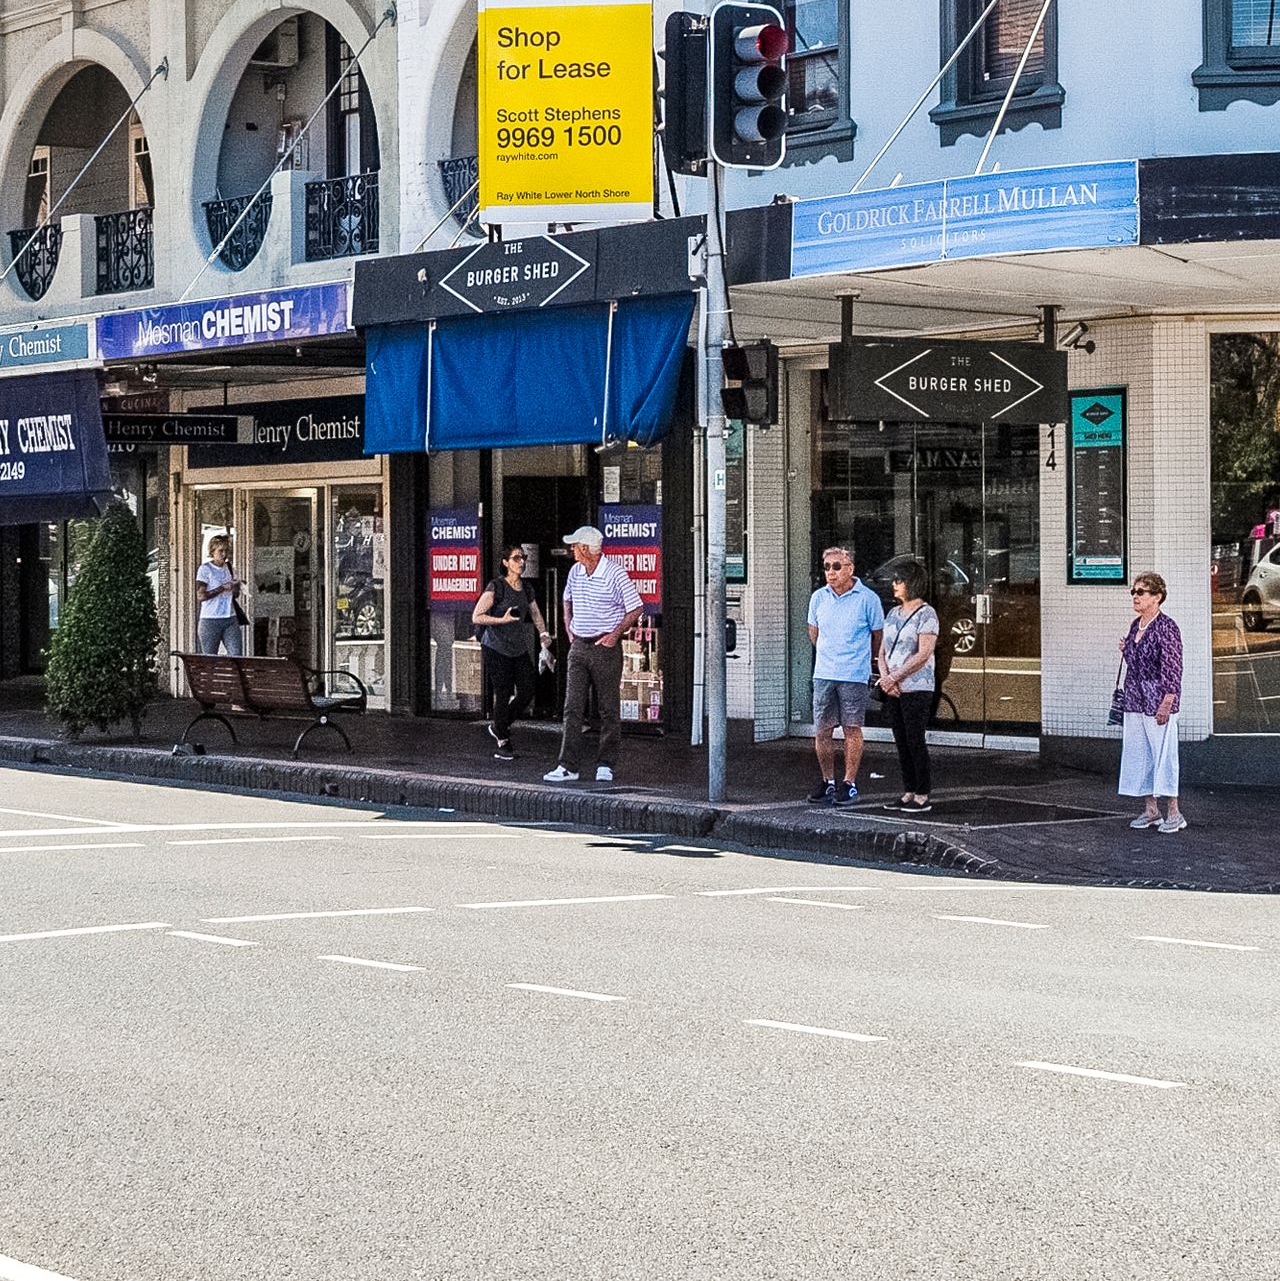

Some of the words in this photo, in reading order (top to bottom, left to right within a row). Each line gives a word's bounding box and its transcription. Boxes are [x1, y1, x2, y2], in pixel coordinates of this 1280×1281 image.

[497, 27, 561, 51] Shop
[497, 60, 531, 80] for
[539, 59, 611, 79] Lease
[496, 108, 539, 123] Scott
[545, 106, 621, 124] Stephens
[496, 127, 555, 149] 9969
[564, 125, 621, 147] 1500
[496, 152, 558, 162] raywhite.com
[496, 192, 514, 201] Ray
[516, 191, 543, 200] White
[545, 190, 573, 199] Lower
[575, 190, 601, 198] North
[603, 189, 630, 198] Shore
[818, 205, 910, 235] GOLDRICK
[913, 194, 995, 223] FARRELL
[997, 183, 1098, 212] MULLAN
[901, 228, 986, 250] SOLICITORS
[504, 242, 523, 255] THE
[467, 267, 519, 287] BURGER
[524, 261, 559, 280] SHED
[512, 294, 527, 306] 2013
[138, 320, 201, 347] Mosman
[202, 300, 294, 340] CHEMIST
[9, 334, 62, 358] Chemist
[951, 356, 971, 367] THE
[909, 376, 967, 391] BURGER
[974, 379, 1012, 393] SHED
[18, 414, 75, 453] CHEMIST
[108, 420, 157, 439] Henry
[162, 420, 225, 436] Chemist
[296, 414, 360, 441] Chemist
[717, 473, 724, 485] H
[604, 513, 633, 523] Mosman
[431, 526, 477, 540] CHEMIST
[604, 523, 657, 538] CHEMIST
[432, 554, 458, 572] UNDER
[459, 554, 476, 571] NEW
[636, 554, 656, 571] NEW
[432, 577, 477, 593] MANAGEMENT
